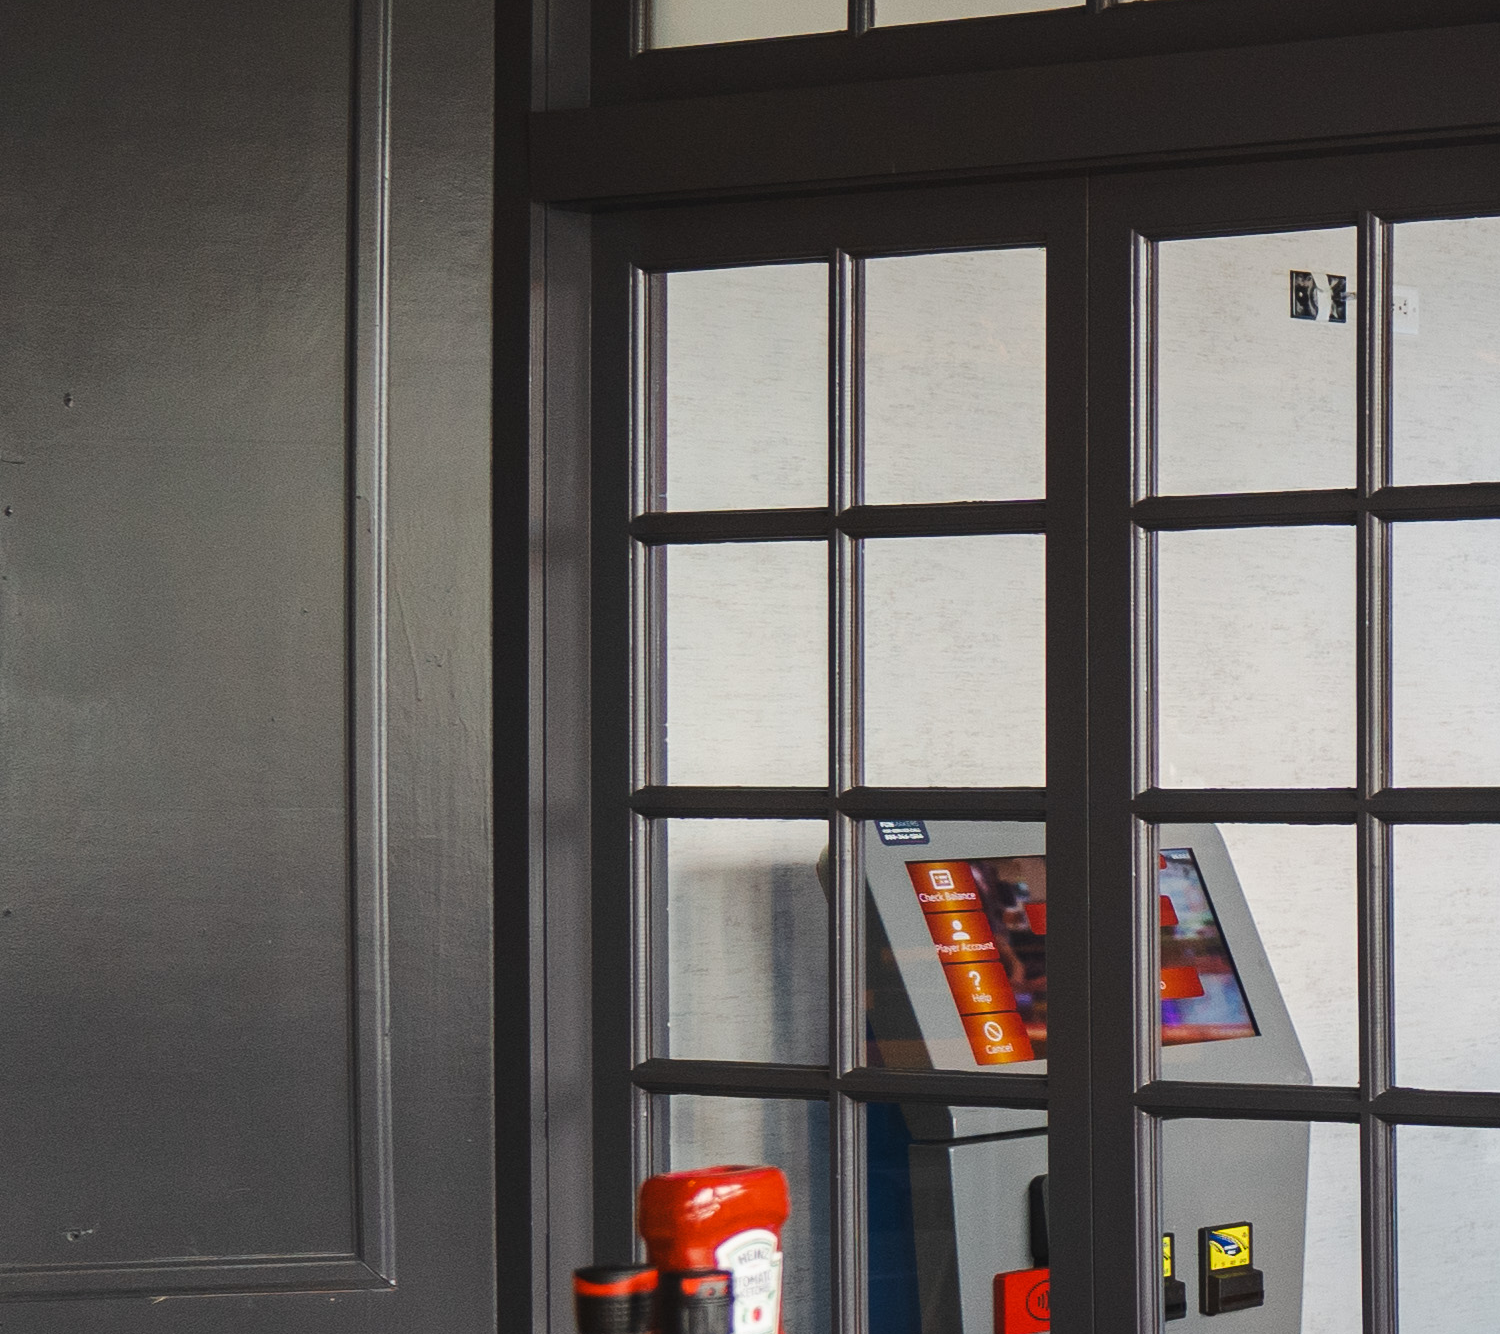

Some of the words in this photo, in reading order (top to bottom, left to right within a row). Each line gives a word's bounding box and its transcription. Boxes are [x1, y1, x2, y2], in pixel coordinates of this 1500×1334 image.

[918, 892, 944, 903] Check
[944, 890, 977, 902] Balance
[971, 992, 993, 1004] Help
[985, 1043, 1015, 1055] Cancel
